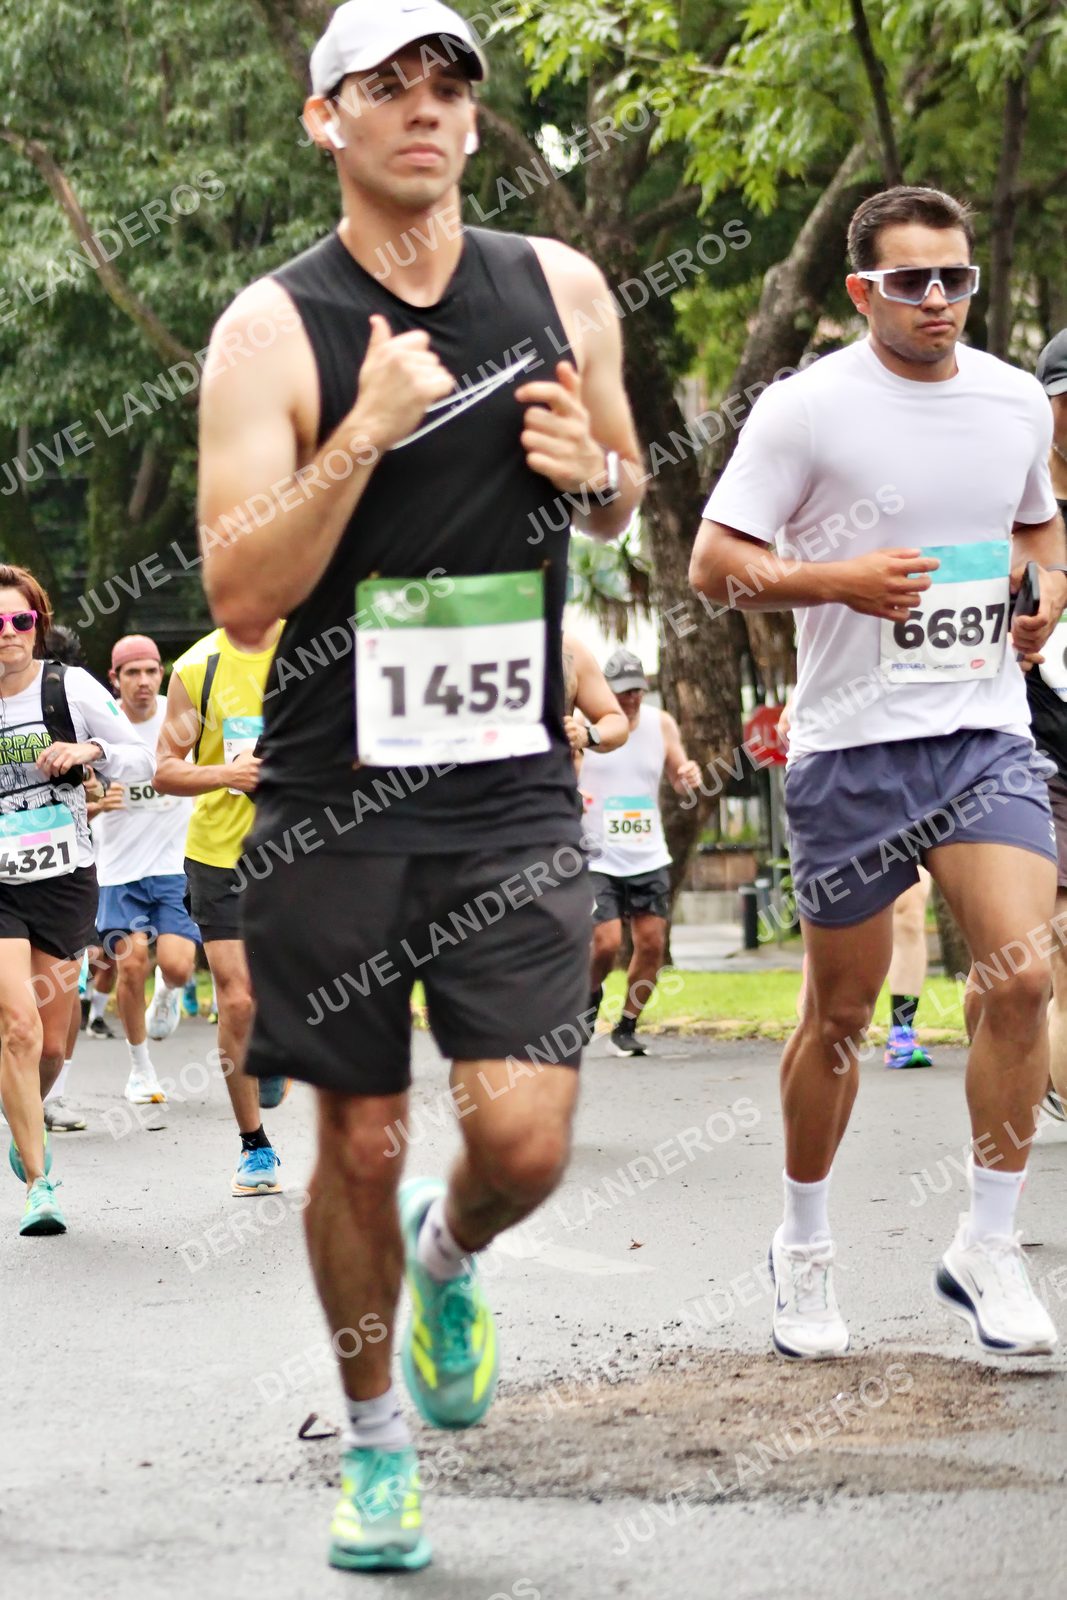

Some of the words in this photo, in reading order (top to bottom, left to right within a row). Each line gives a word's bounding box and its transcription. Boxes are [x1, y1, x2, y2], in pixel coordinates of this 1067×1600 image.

[893, 602, 1006, 650] 6687
[381, 658, 531, 717] 1455
[129, 785, 165, 801] 50
[608, 819, 652, 834] 3063
[0, 841, 70, 876] 4321
